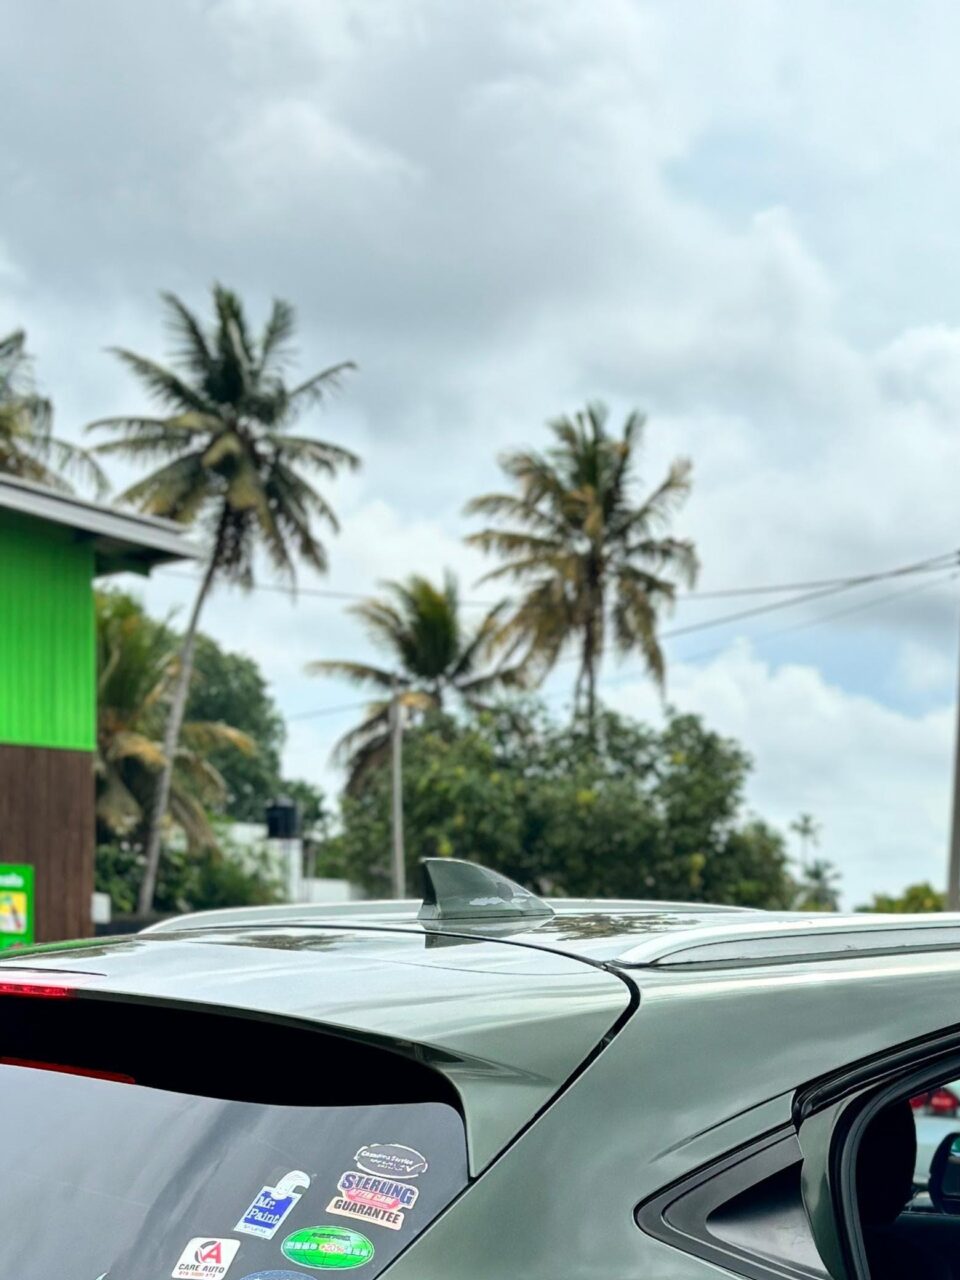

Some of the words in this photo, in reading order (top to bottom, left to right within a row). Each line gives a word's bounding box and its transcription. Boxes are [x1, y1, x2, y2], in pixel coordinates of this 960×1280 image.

[341, 1174, 415, 1205] STERLING
[256, 1196, 276, 1210] Mr.
[247, 1208, 280, 1224] Paint
[333, 1199, 401, 1224] GUARANTEE
[178, 1263, 201, 1271] CARE
[202, 1265, 225, 1274] AUTO
